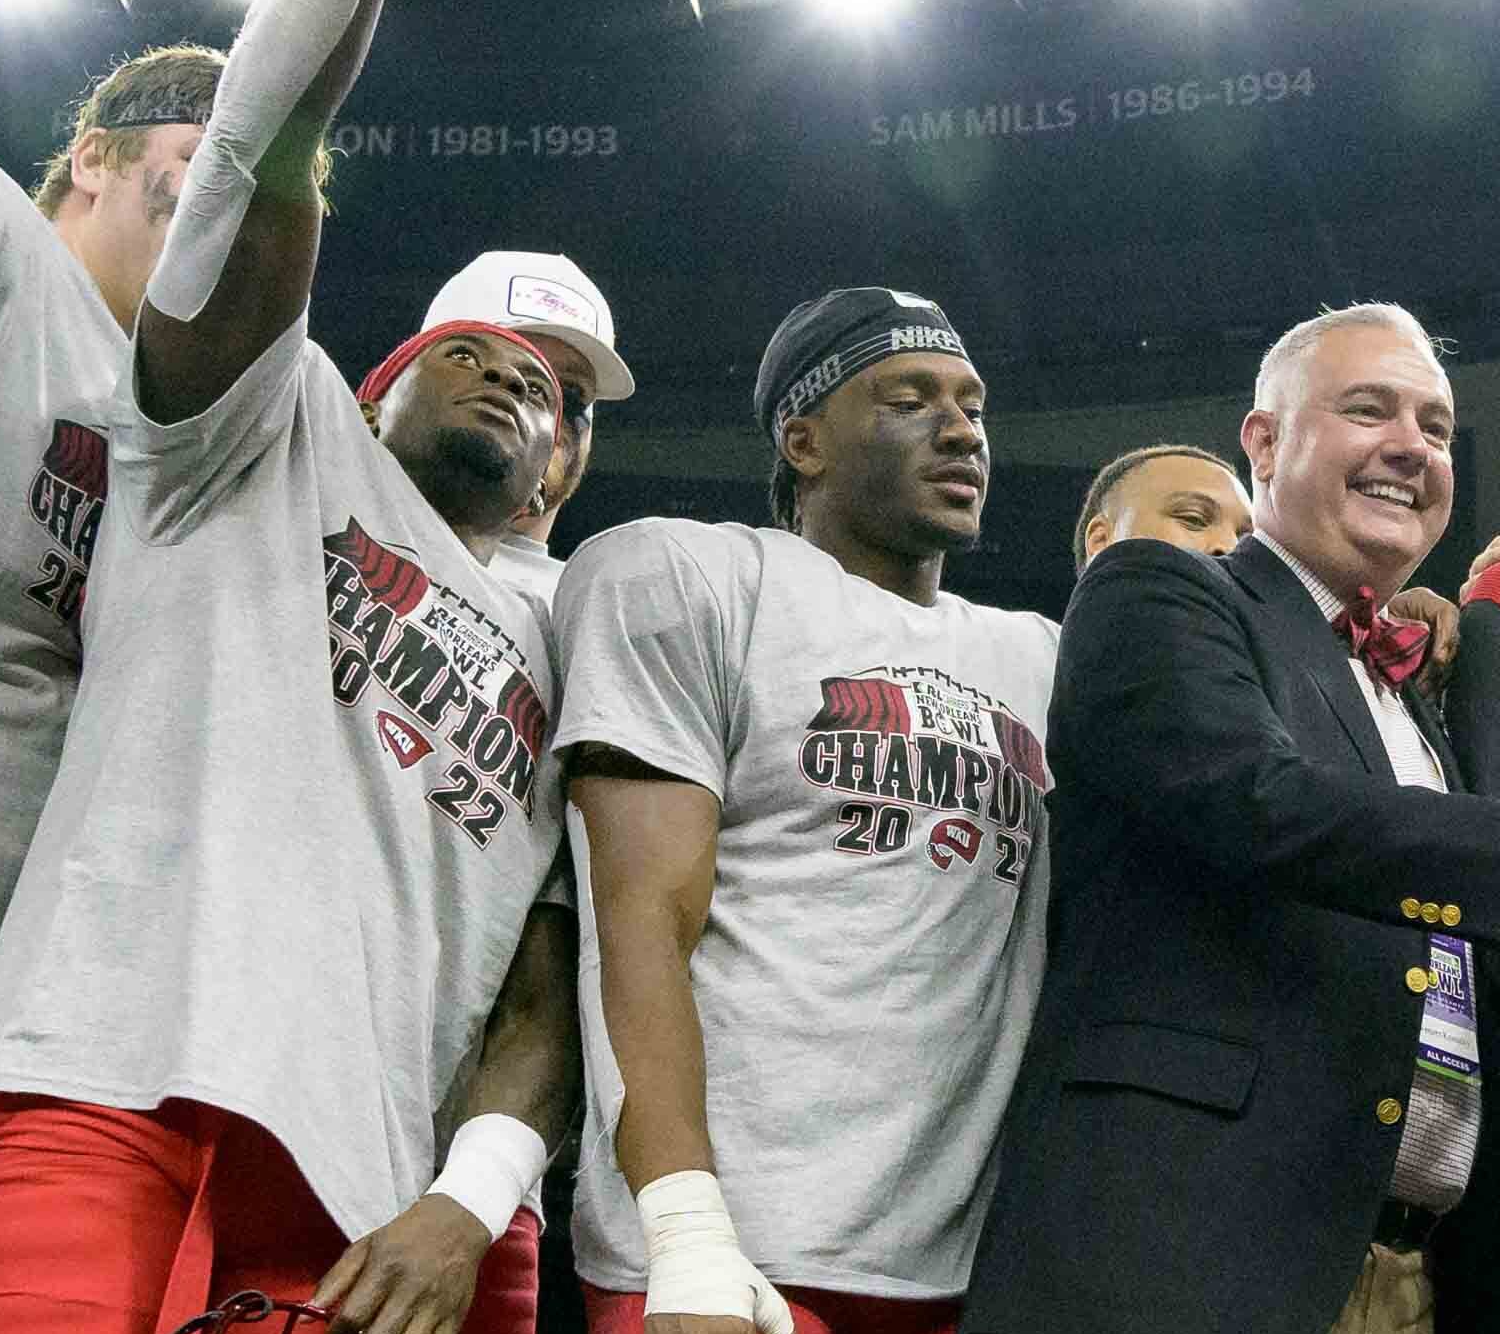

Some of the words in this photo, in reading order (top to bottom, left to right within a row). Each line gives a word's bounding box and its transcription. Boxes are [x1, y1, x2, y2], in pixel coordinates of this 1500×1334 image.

[869, 111, 955, 147] SAM
[964, 97, 1078, 139] MILLS
[1107, 67, 1317, 122] 1986-1994
[426, 124, 619, 157] 1981-1993
[424, 759, 509, 851] 22
[833, 799, 913, 855] 20
[1425, 1050, 1441, 1062] ALL
[1442, 1053, 1471, 1072] ACCESS
